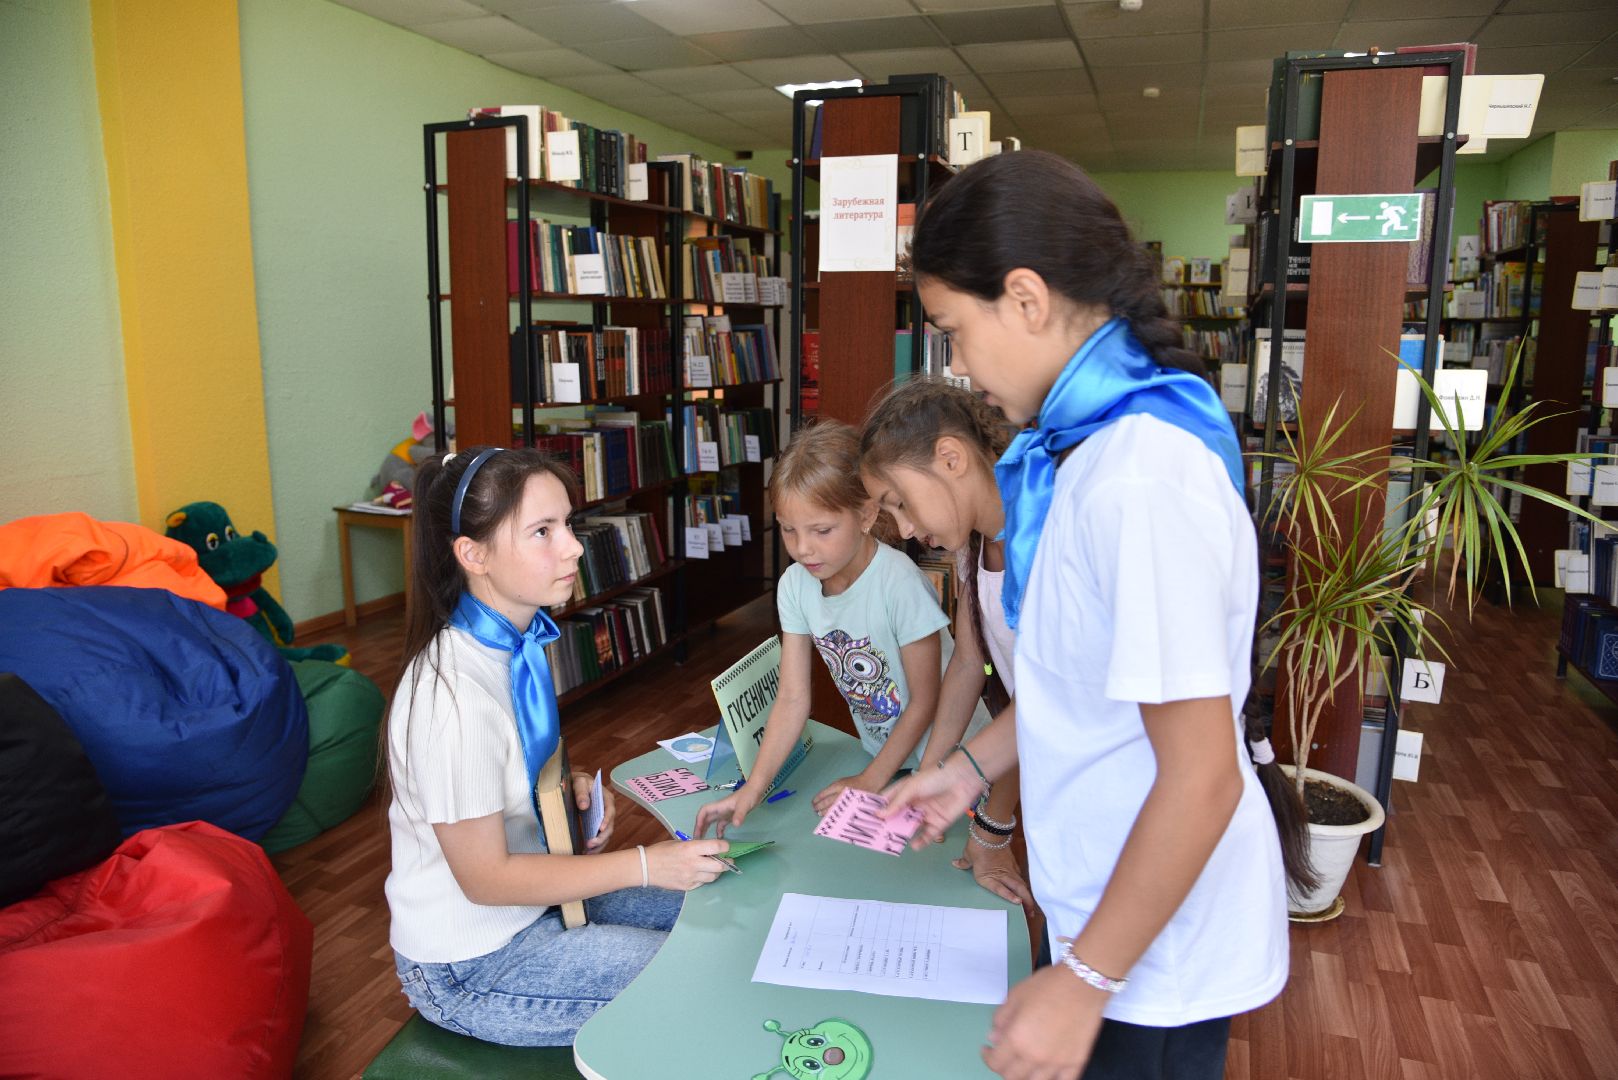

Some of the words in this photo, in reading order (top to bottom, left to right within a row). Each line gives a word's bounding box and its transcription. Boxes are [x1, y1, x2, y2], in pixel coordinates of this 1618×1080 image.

[957, 131, 973, 151] Т
[832, 197, 885, 208] Зарубежная
[832, 211, 884, 222] литература
[1414, 671, 1431, 689] Б
